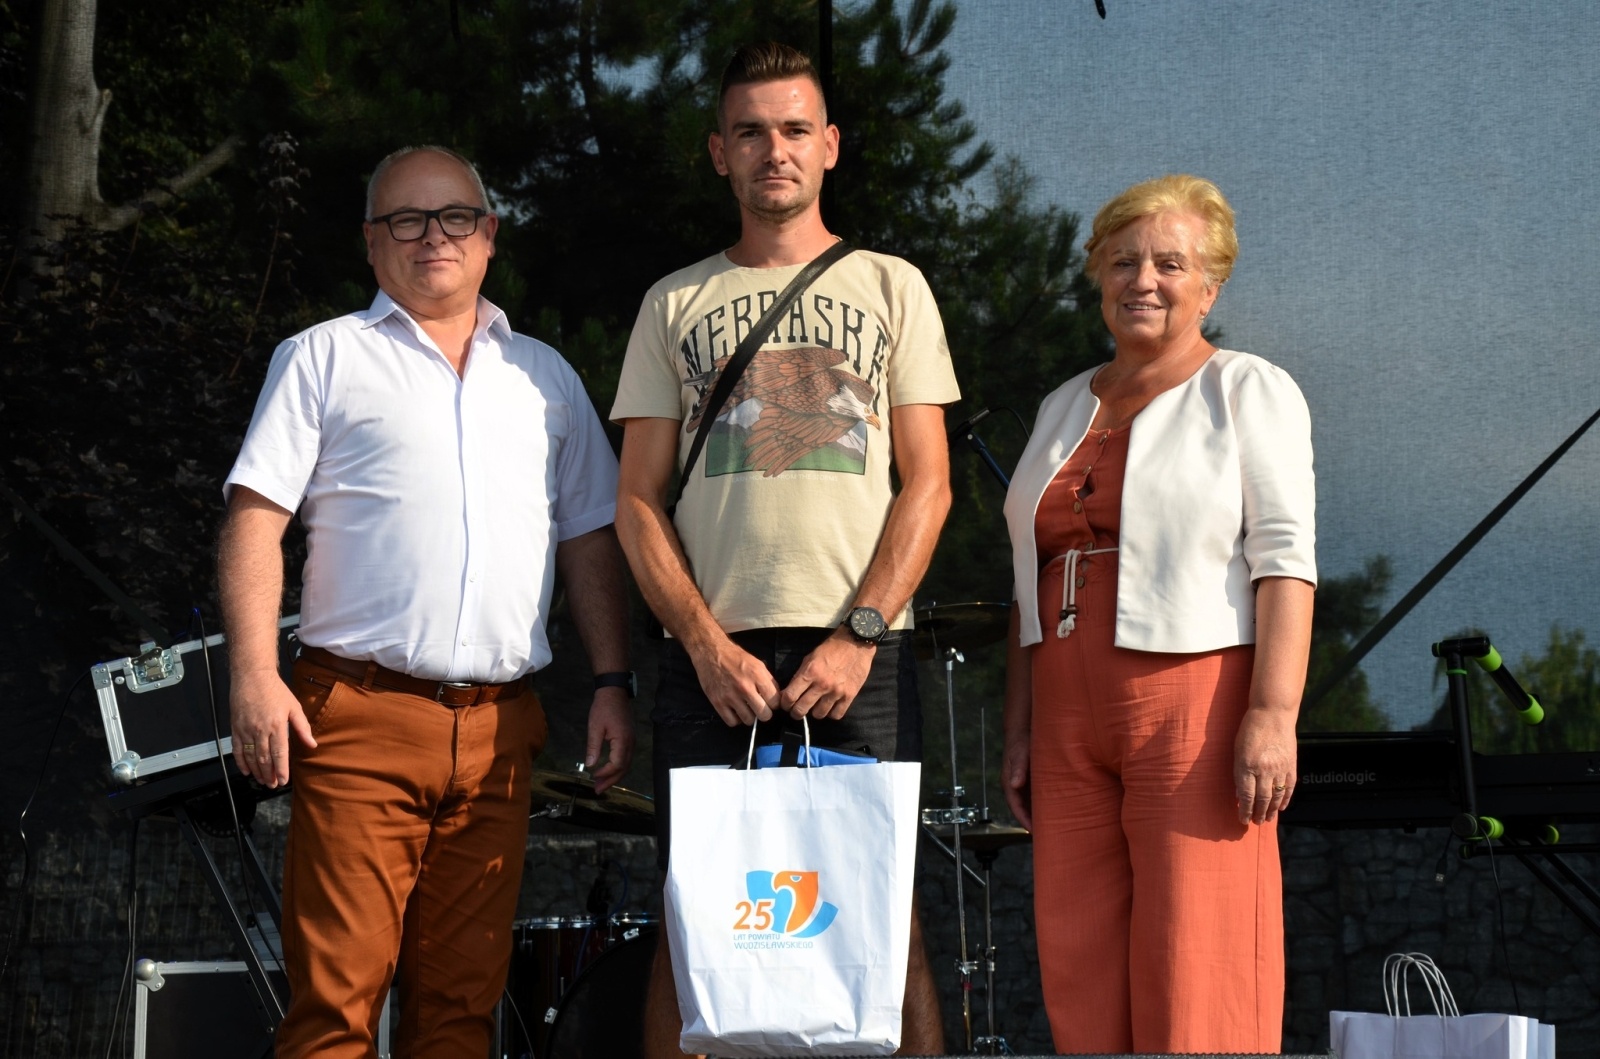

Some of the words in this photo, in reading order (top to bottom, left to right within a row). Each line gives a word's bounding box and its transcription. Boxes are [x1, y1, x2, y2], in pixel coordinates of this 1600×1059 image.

[1302, 769, 1377, 785] studiologic
[732, 900, 772, 931] 25
[733, 933, 746, 941] LAT
[748, 933, 781, 941] POWIATU
[733, 941, 814, 950] WODZISŁAWSKIEGO
